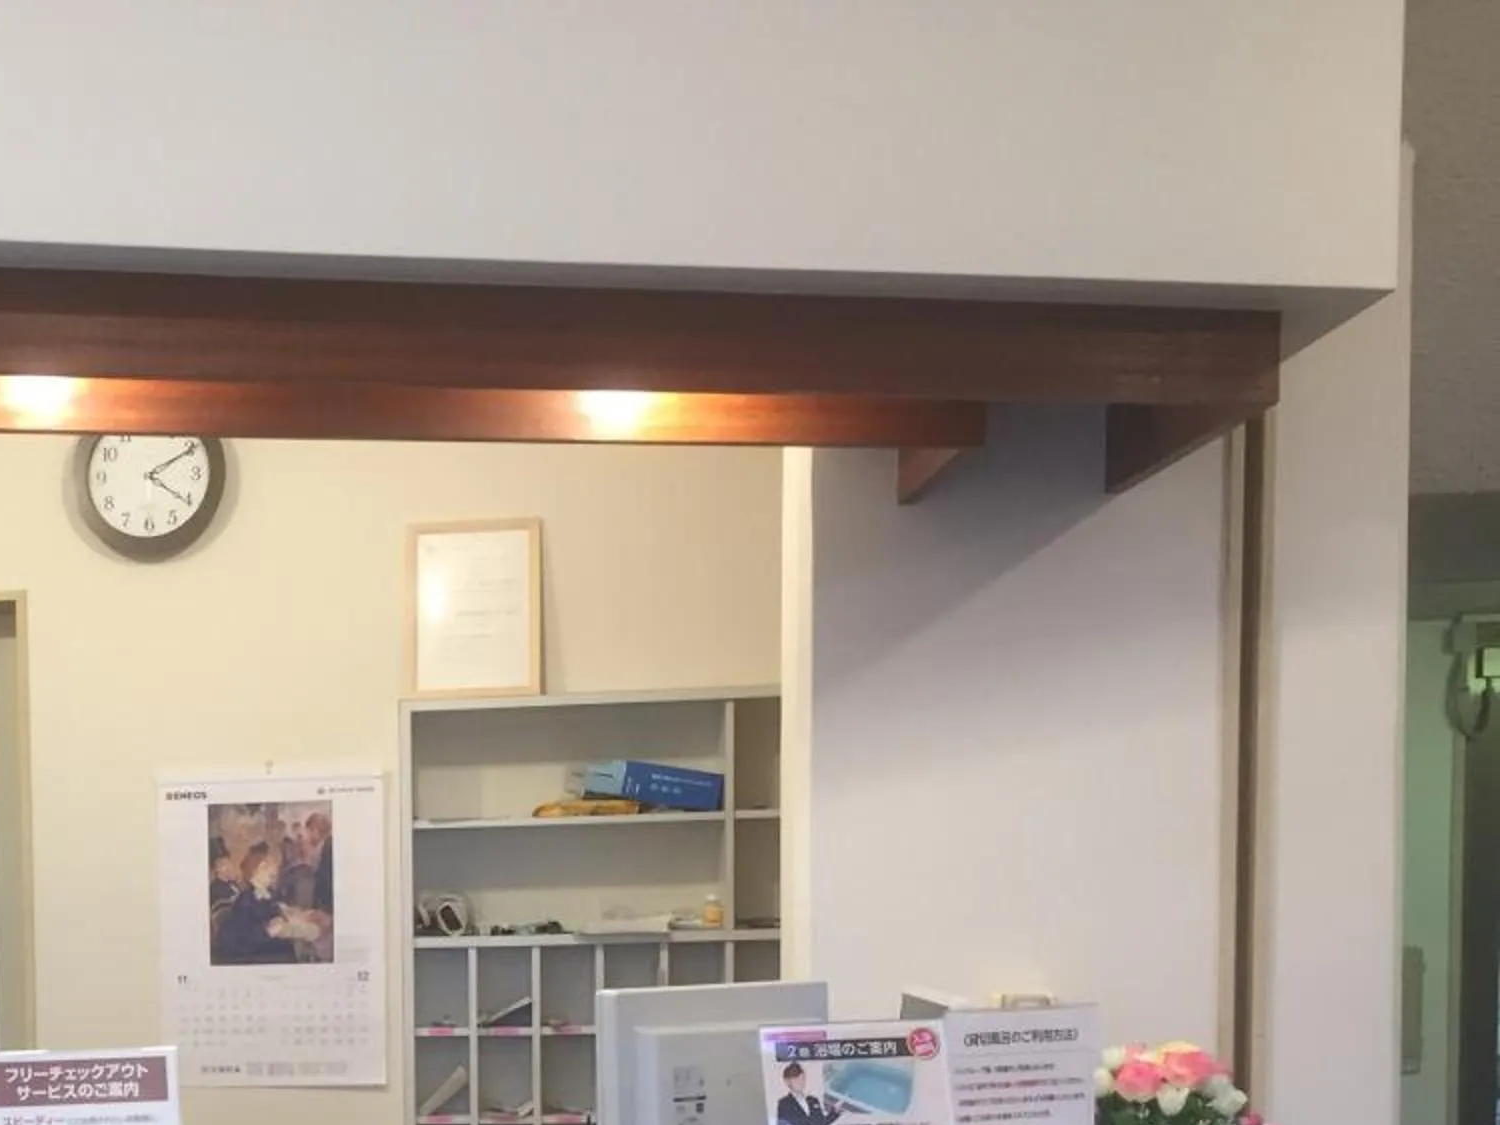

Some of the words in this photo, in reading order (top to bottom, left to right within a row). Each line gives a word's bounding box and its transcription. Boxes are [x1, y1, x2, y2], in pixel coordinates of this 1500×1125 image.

[103, 447, 118, 462] 10
[96, 471, 107, 483] 9
[190, 466, 202, 481] 3
[104, 496, 115, 510] 8
[121, 512, 131, 527] 7
[144, 516, 155, 531] 6
[168, 509, 178, 525] 5
[4, 1063, 149, 1083] フリーチェックアウト
[16, 1081, 140, 1101] サービスのご案内
